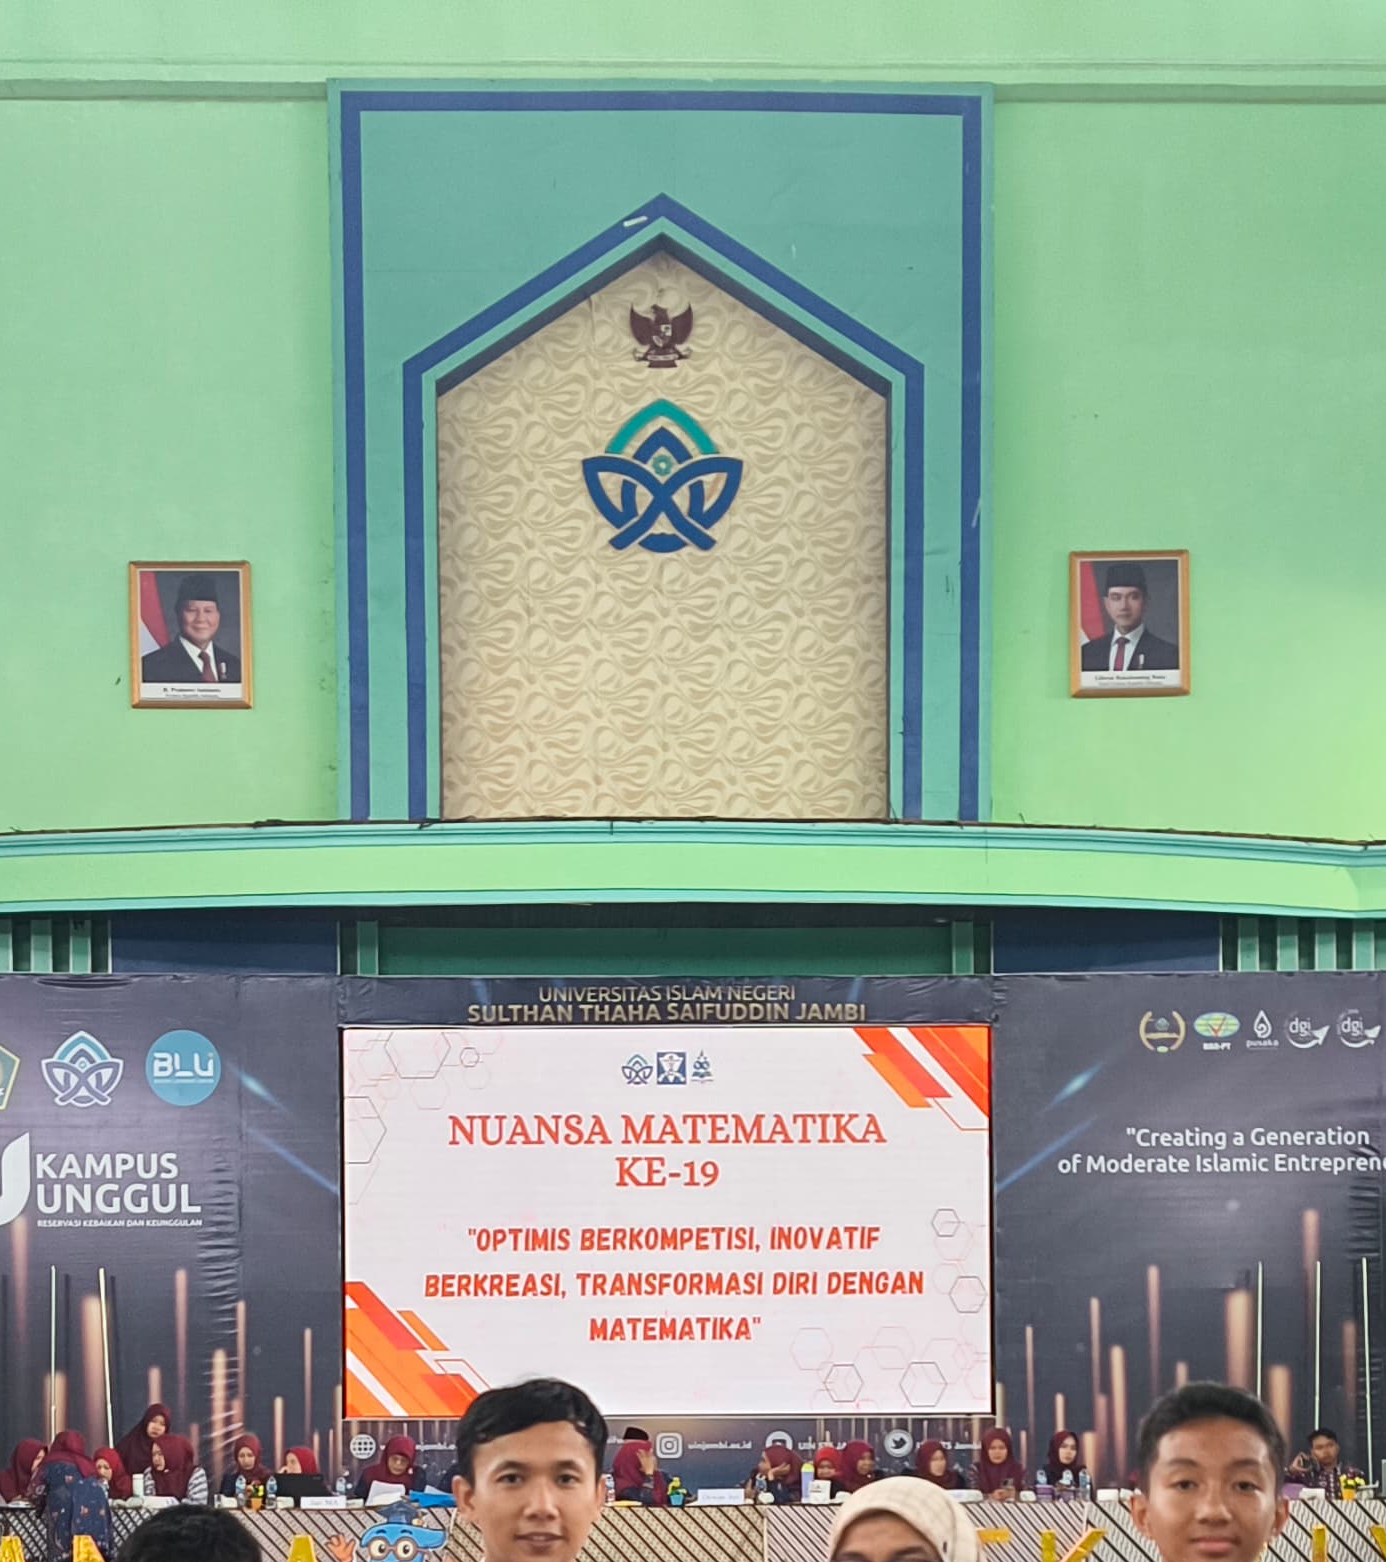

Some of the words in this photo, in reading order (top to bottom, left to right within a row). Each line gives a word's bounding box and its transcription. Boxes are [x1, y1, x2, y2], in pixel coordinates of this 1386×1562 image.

[539, 986, 661, 1002] UNIVERSITAS
[666, 986, 724, 1001] ISLAM
[727, 985, 795, 1000] NEGERI
[468, 1004, 574, 1022] SULTHAN
[579, 1003, 662, 1021] THAHA
[667, 1003, 790, 1021] SAIFUDDIN
[795, 1002, 866, 1021] JAMBI
[1289, 1017, 1311, 1036] dgi
[1341, 1018, 1363, 1036] dgi
[153, 1052, 213, 1077] BLU
[448, 1115, 612, 1145] NUANSA
[620, 1114, 886, 1143] MATEMATIKA
[1126, 1128, 1226, 1149] "Creating
[1233, 1132, 1245, 1145] a
[1251, 1127, 1370, 1146] Generation
[36, 1153, 178, 1179] KAMPUS
[615, 1157, 720, 1186] KE-19
[1058, 1155, 1082, 1174] of
[1086, 1155, 1190, 1173] Moderate
[1196, 1153, 1269, 1173] Islamic
[37, 1184, 201, 1214] UNGGUL
[37, 1220, 81, 1228] RESERVASI
[126, 1219, 145, 1227] DAN
[146, 1219, 202, 1227] KEUNGGULAN
[468, 1227, 571, 1251] "OPTIMIS
[580, 1227, 760, 1253] BERKOMPETISI,
[769, 1226, 880, 1250] INOVATIF
[424, 1273, 567, 1298] BERKREASI,
[577, 1272, 763, 1296] TRANSFORMASI
[772, 1272, 816, 1295] DIRI
[827, 1271, 924, 1295] DENGAN
[589, 1317, 761, 1341] MATEMATIKA"
